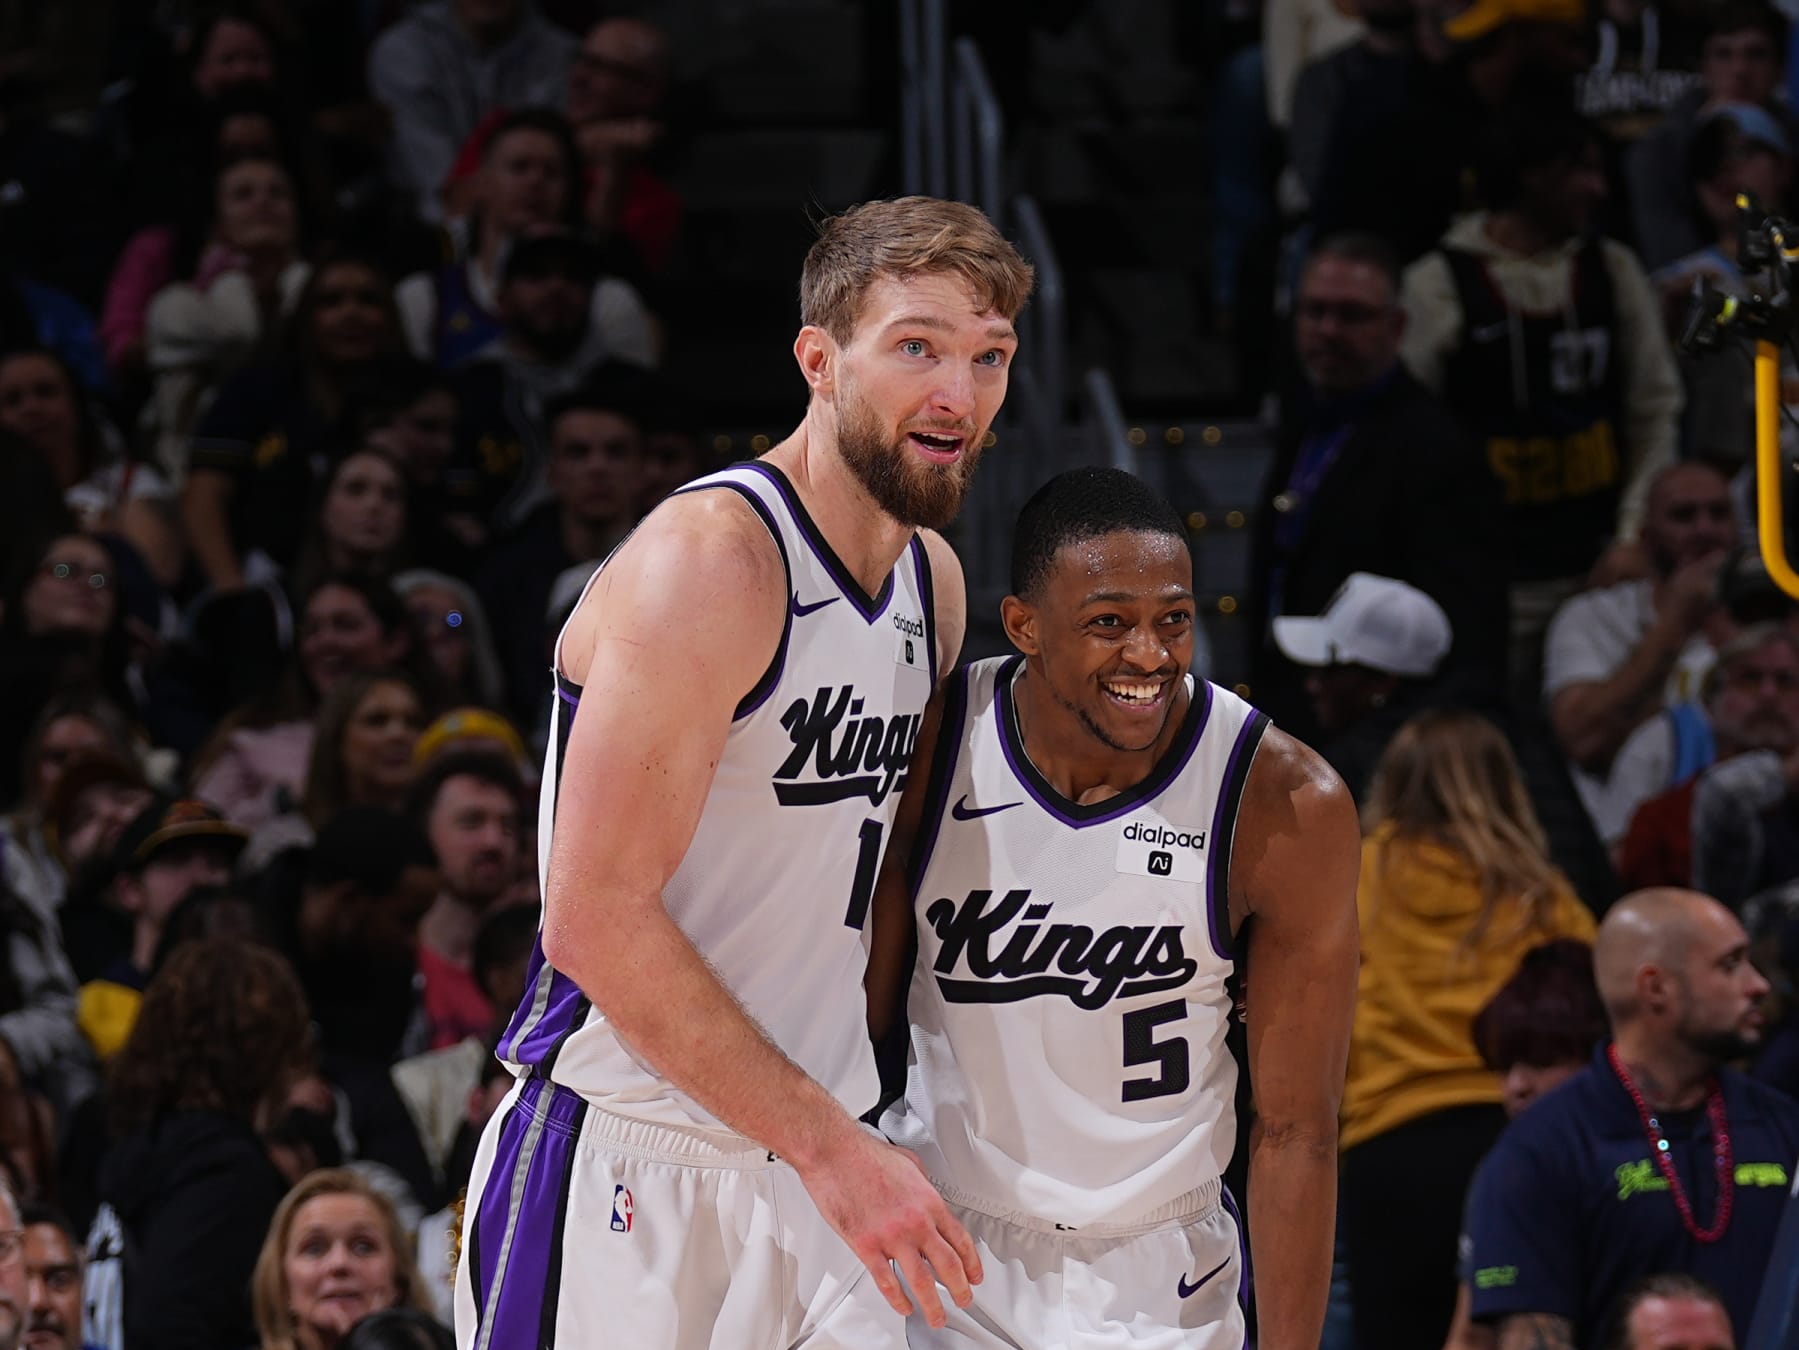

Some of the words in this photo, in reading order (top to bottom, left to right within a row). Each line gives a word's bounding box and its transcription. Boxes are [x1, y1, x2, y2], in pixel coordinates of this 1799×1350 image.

[893, 612, 924, 638] dialpad
[1123, 822, 1206, 850] dialpad
[925, 889, 1198, 1010] Kings
[1121, 998, 1191, 1103] 5
